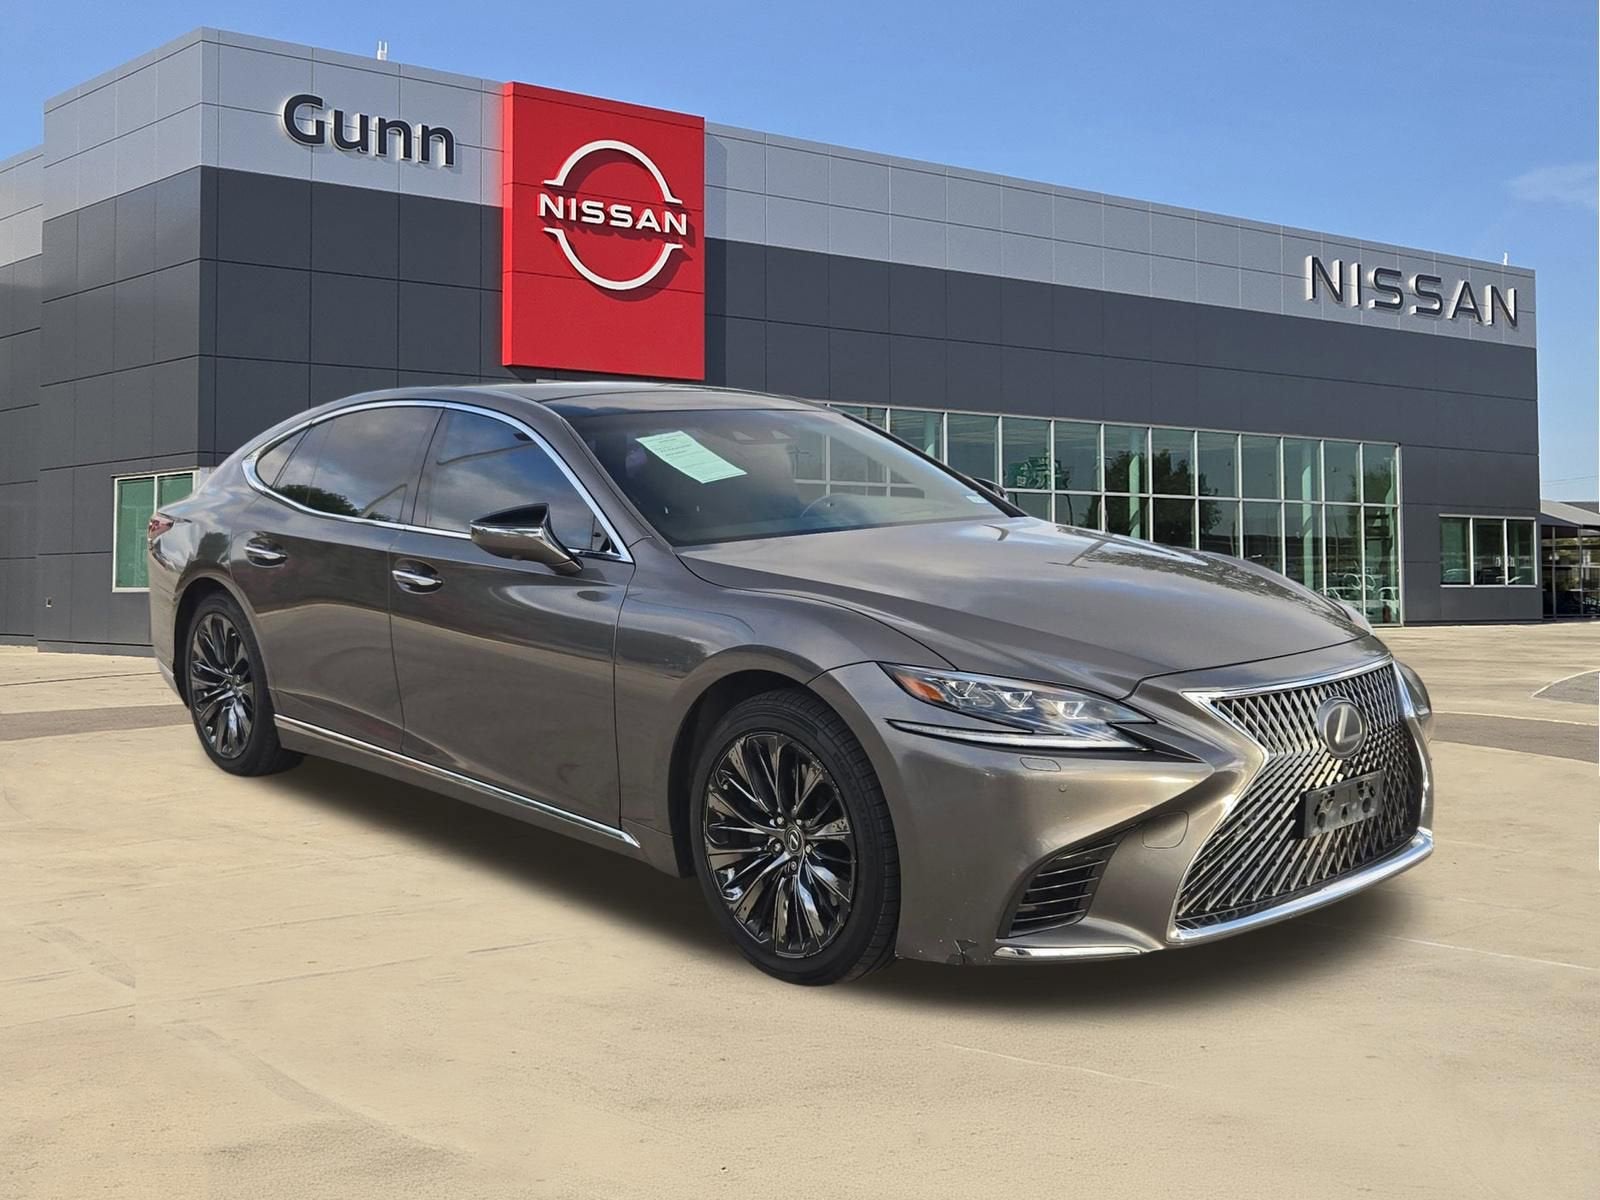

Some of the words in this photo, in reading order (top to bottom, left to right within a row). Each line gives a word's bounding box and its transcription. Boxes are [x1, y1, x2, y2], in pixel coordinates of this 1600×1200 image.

[282, 94, 456, 167] Gunn
[537, 193, 688, 235] NISSAN
[1305, 255, 1518, 327] NISSAN
